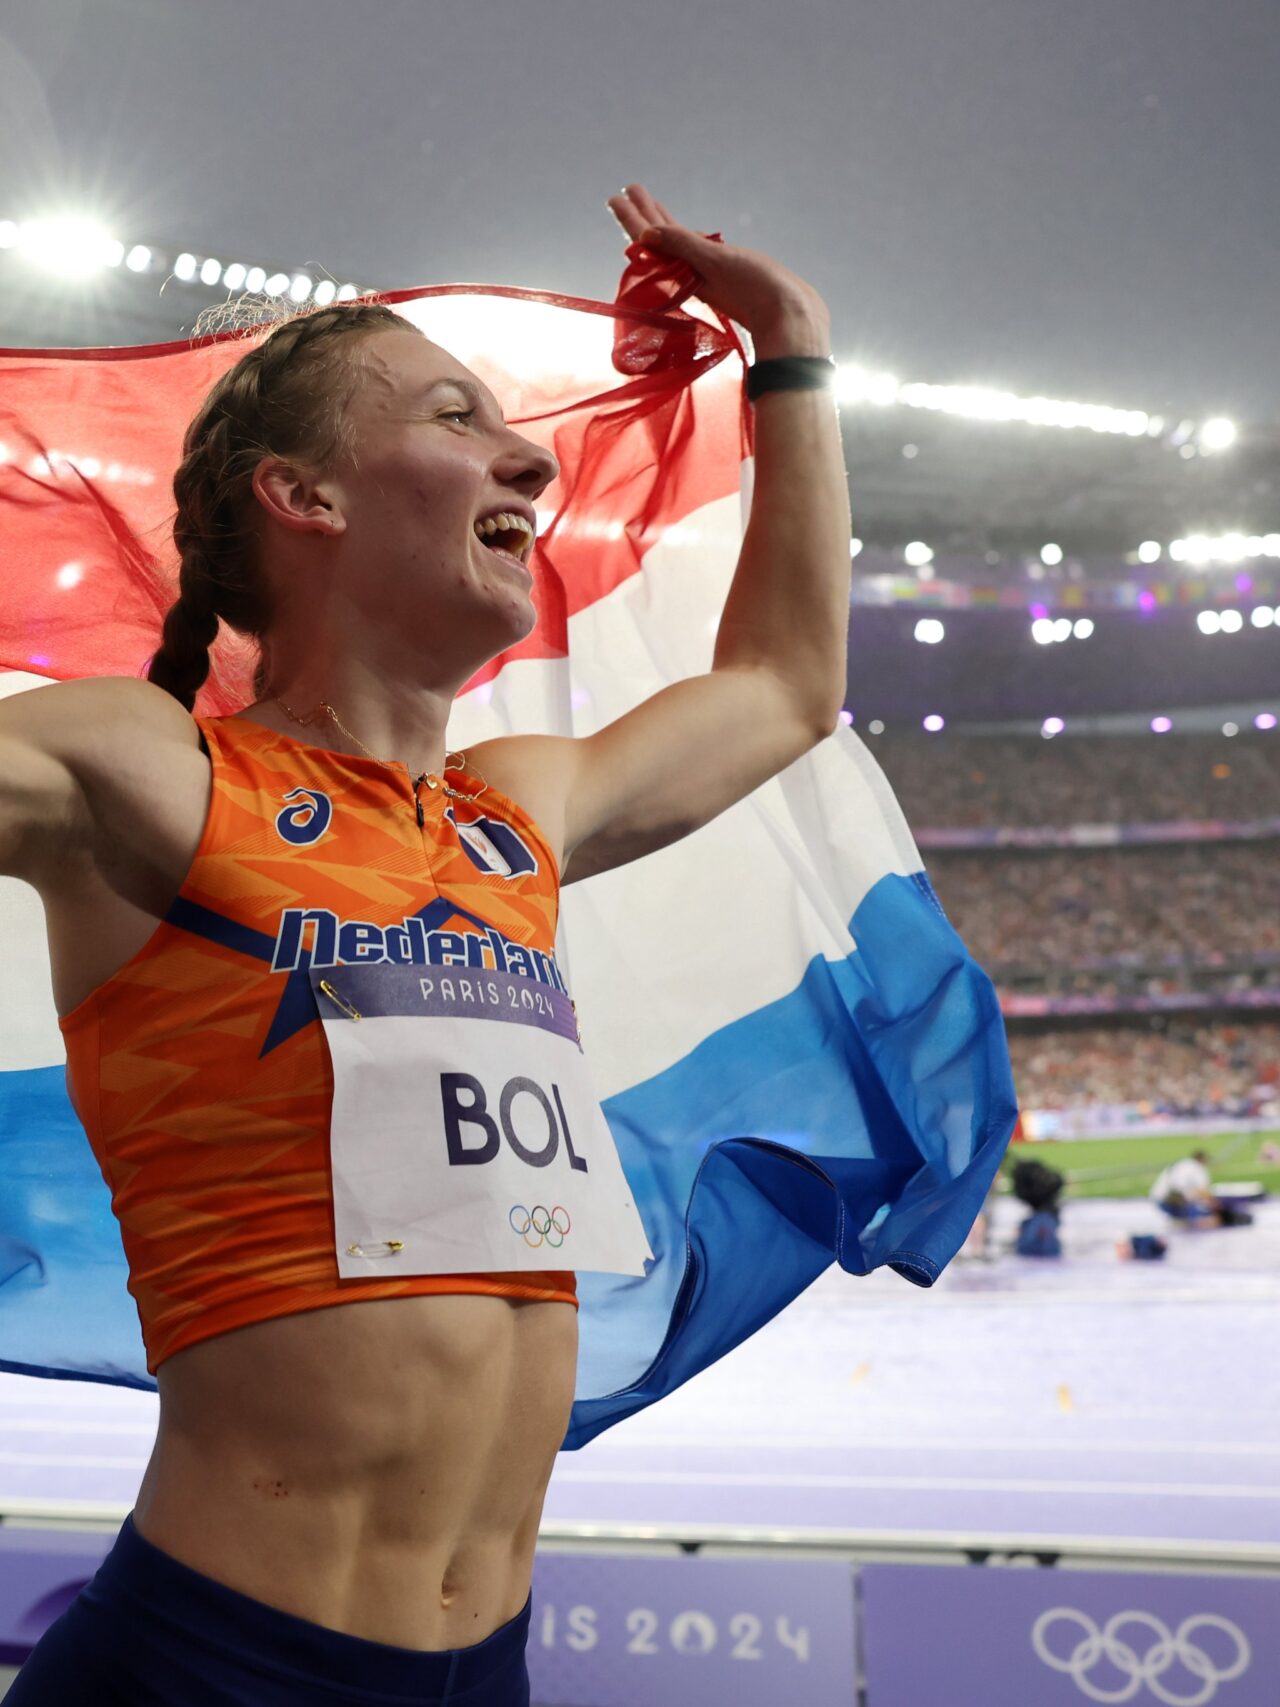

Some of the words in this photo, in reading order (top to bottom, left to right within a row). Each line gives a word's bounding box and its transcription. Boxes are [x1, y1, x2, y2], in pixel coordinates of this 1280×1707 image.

[270, 907, 569, 998] Nederlan
[419, 977, 500, 1006] PARIS
[507, 985, 555, 1019] 2024
[439, 1072, 589, 1174] BOL
[625, 1606, 811, 1663] 2024
